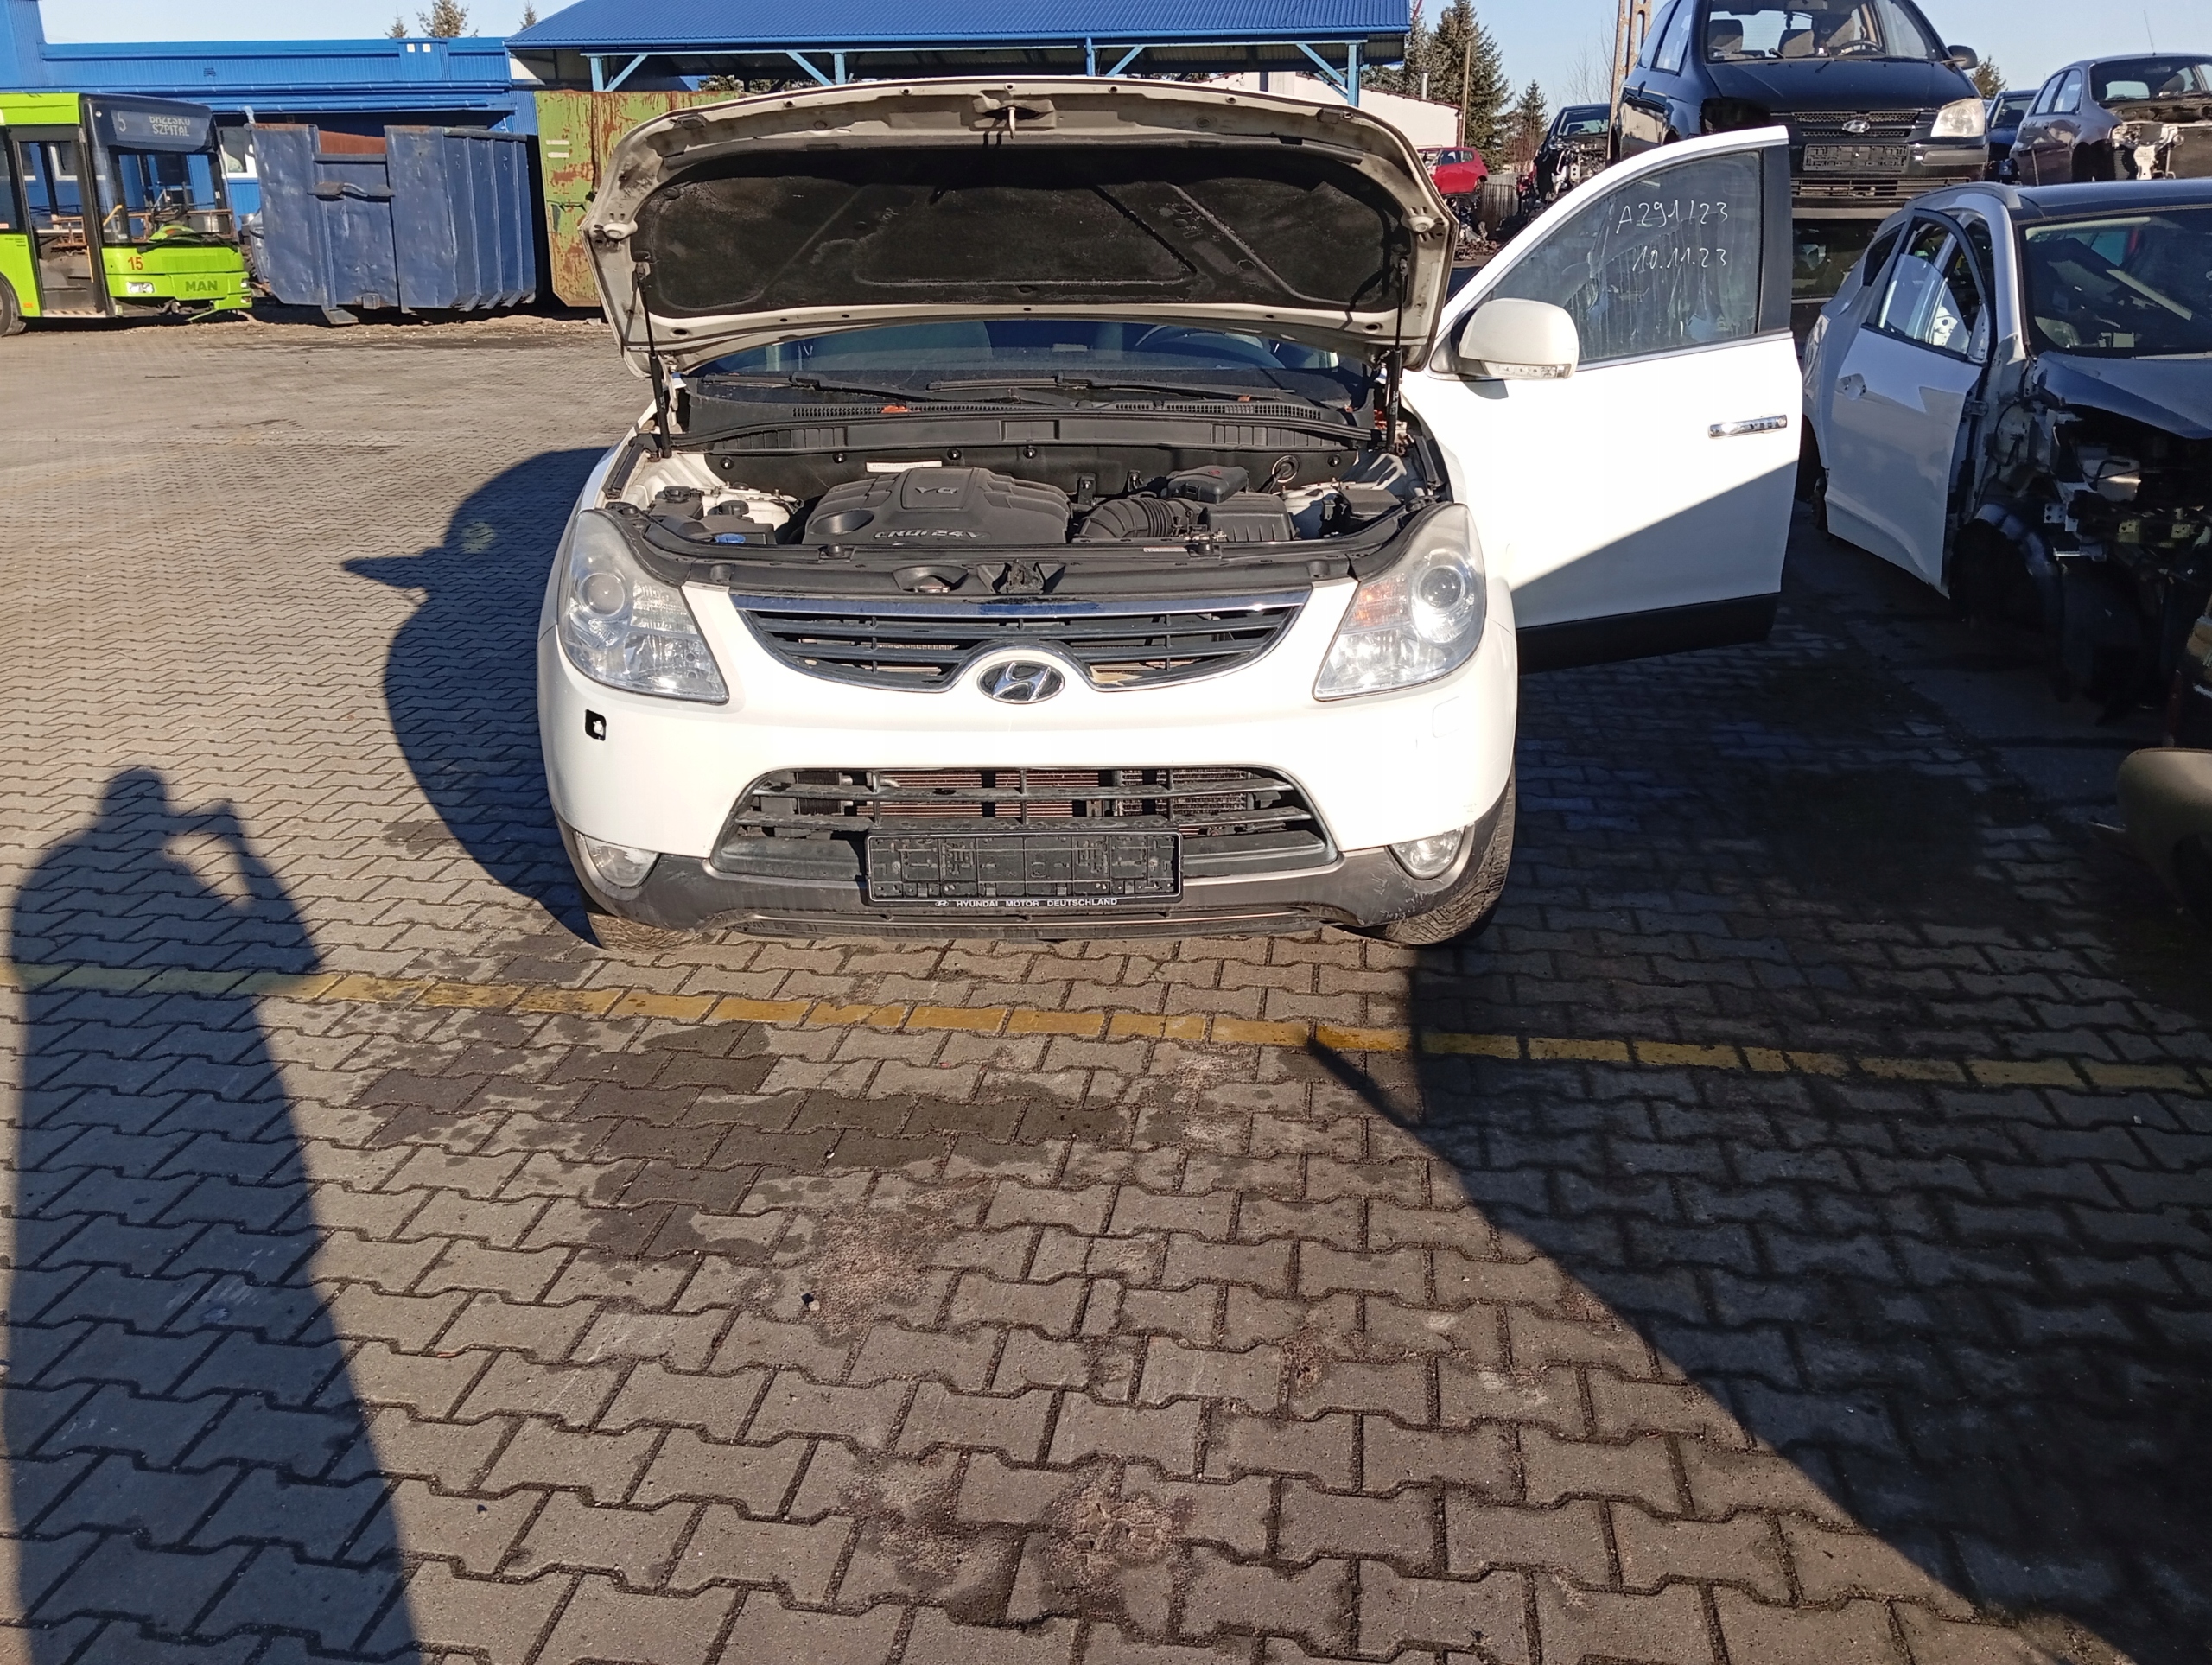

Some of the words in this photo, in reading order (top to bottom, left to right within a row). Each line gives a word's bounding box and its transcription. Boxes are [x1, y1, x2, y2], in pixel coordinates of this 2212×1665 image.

[152, 124, 190, 137] SZPITAL
[127, 257, 144, 270] 15
[1632, 245, 1727, 272] 10.11.23
[185, 280, 218, 292] MAN
[1046, 898, 1118, 907] DEUTSCHLAND
